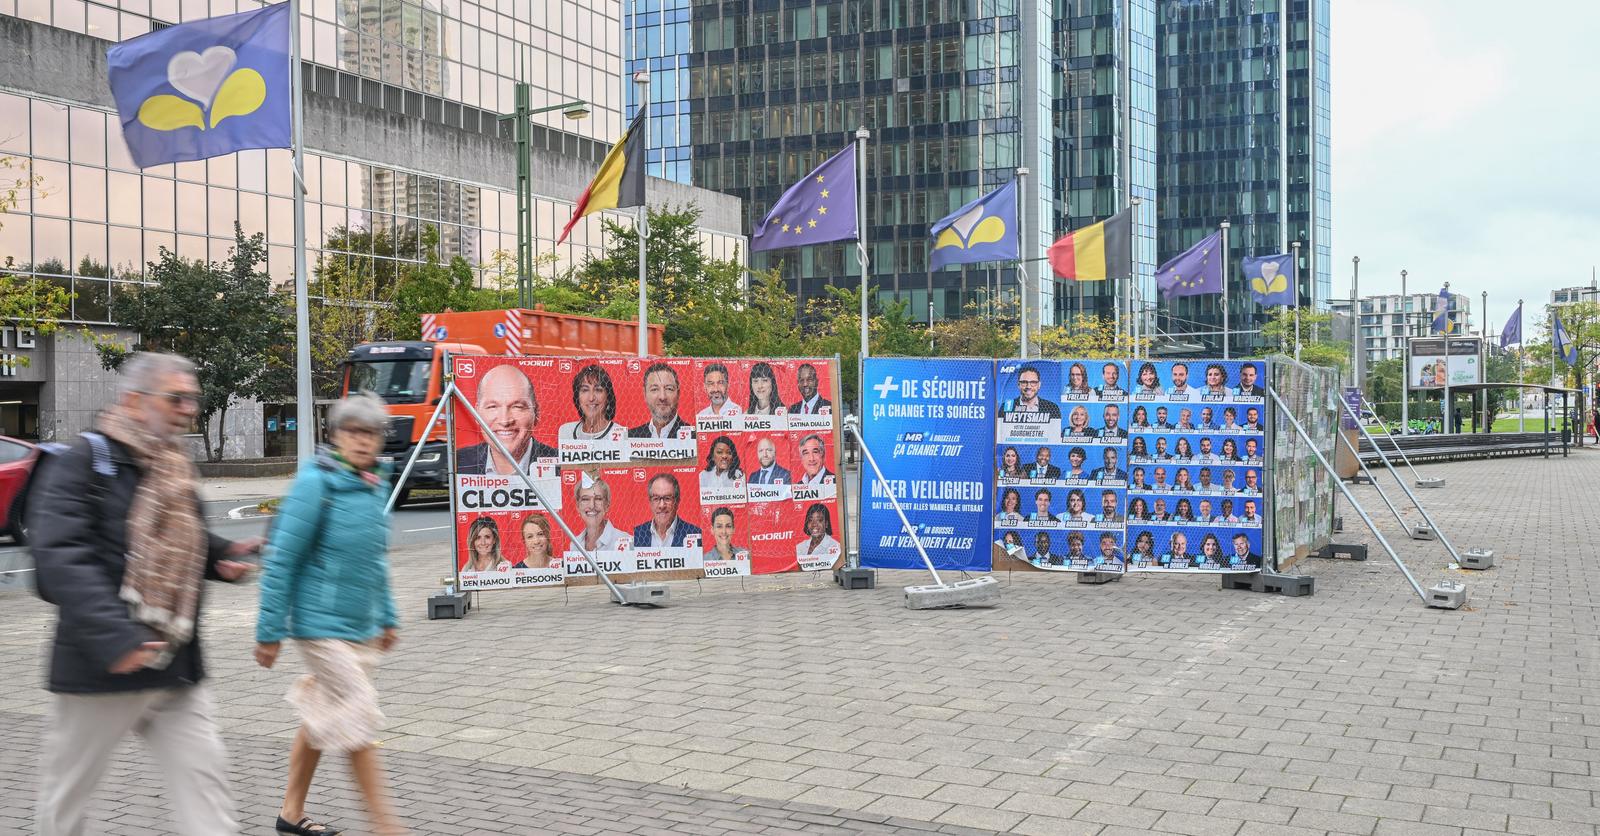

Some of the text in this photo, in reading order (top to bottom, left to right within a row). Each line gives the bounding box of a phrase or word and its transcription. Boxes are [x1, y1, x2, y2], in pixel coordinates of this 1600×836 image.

[902, 380, 918, 398] DE
[922, 376, 986, 399] SÉCURITÉ
[873, 403, 985, 420] ÇA CHANGE TES SOIRÉES
[1005, 412, 1050, 423] WEYTSMAN
[699, 421, 732, 430] TAHIRI
[562, 450, 620, 462] HARICHE
[893, 444, 964, 458] ÇA CHANGE TOUT
[461, 477, 509, 488] Philippe
[794, 490, 819, 500] ZIAN
[911, 480, 983, 500] VEILIGHEID
[462, 489, 538, 508] CLOSE
[752, 530, 794, 541] VOORUIT
[880, 535, 898, 547] DAT
[946, 538, 973, 549] ALLES
[637, 558, 684, 570] EL KTIBI
[480, 578, 510, 586] HAMOU
[516, 574, 562, 584] PERSOONS
